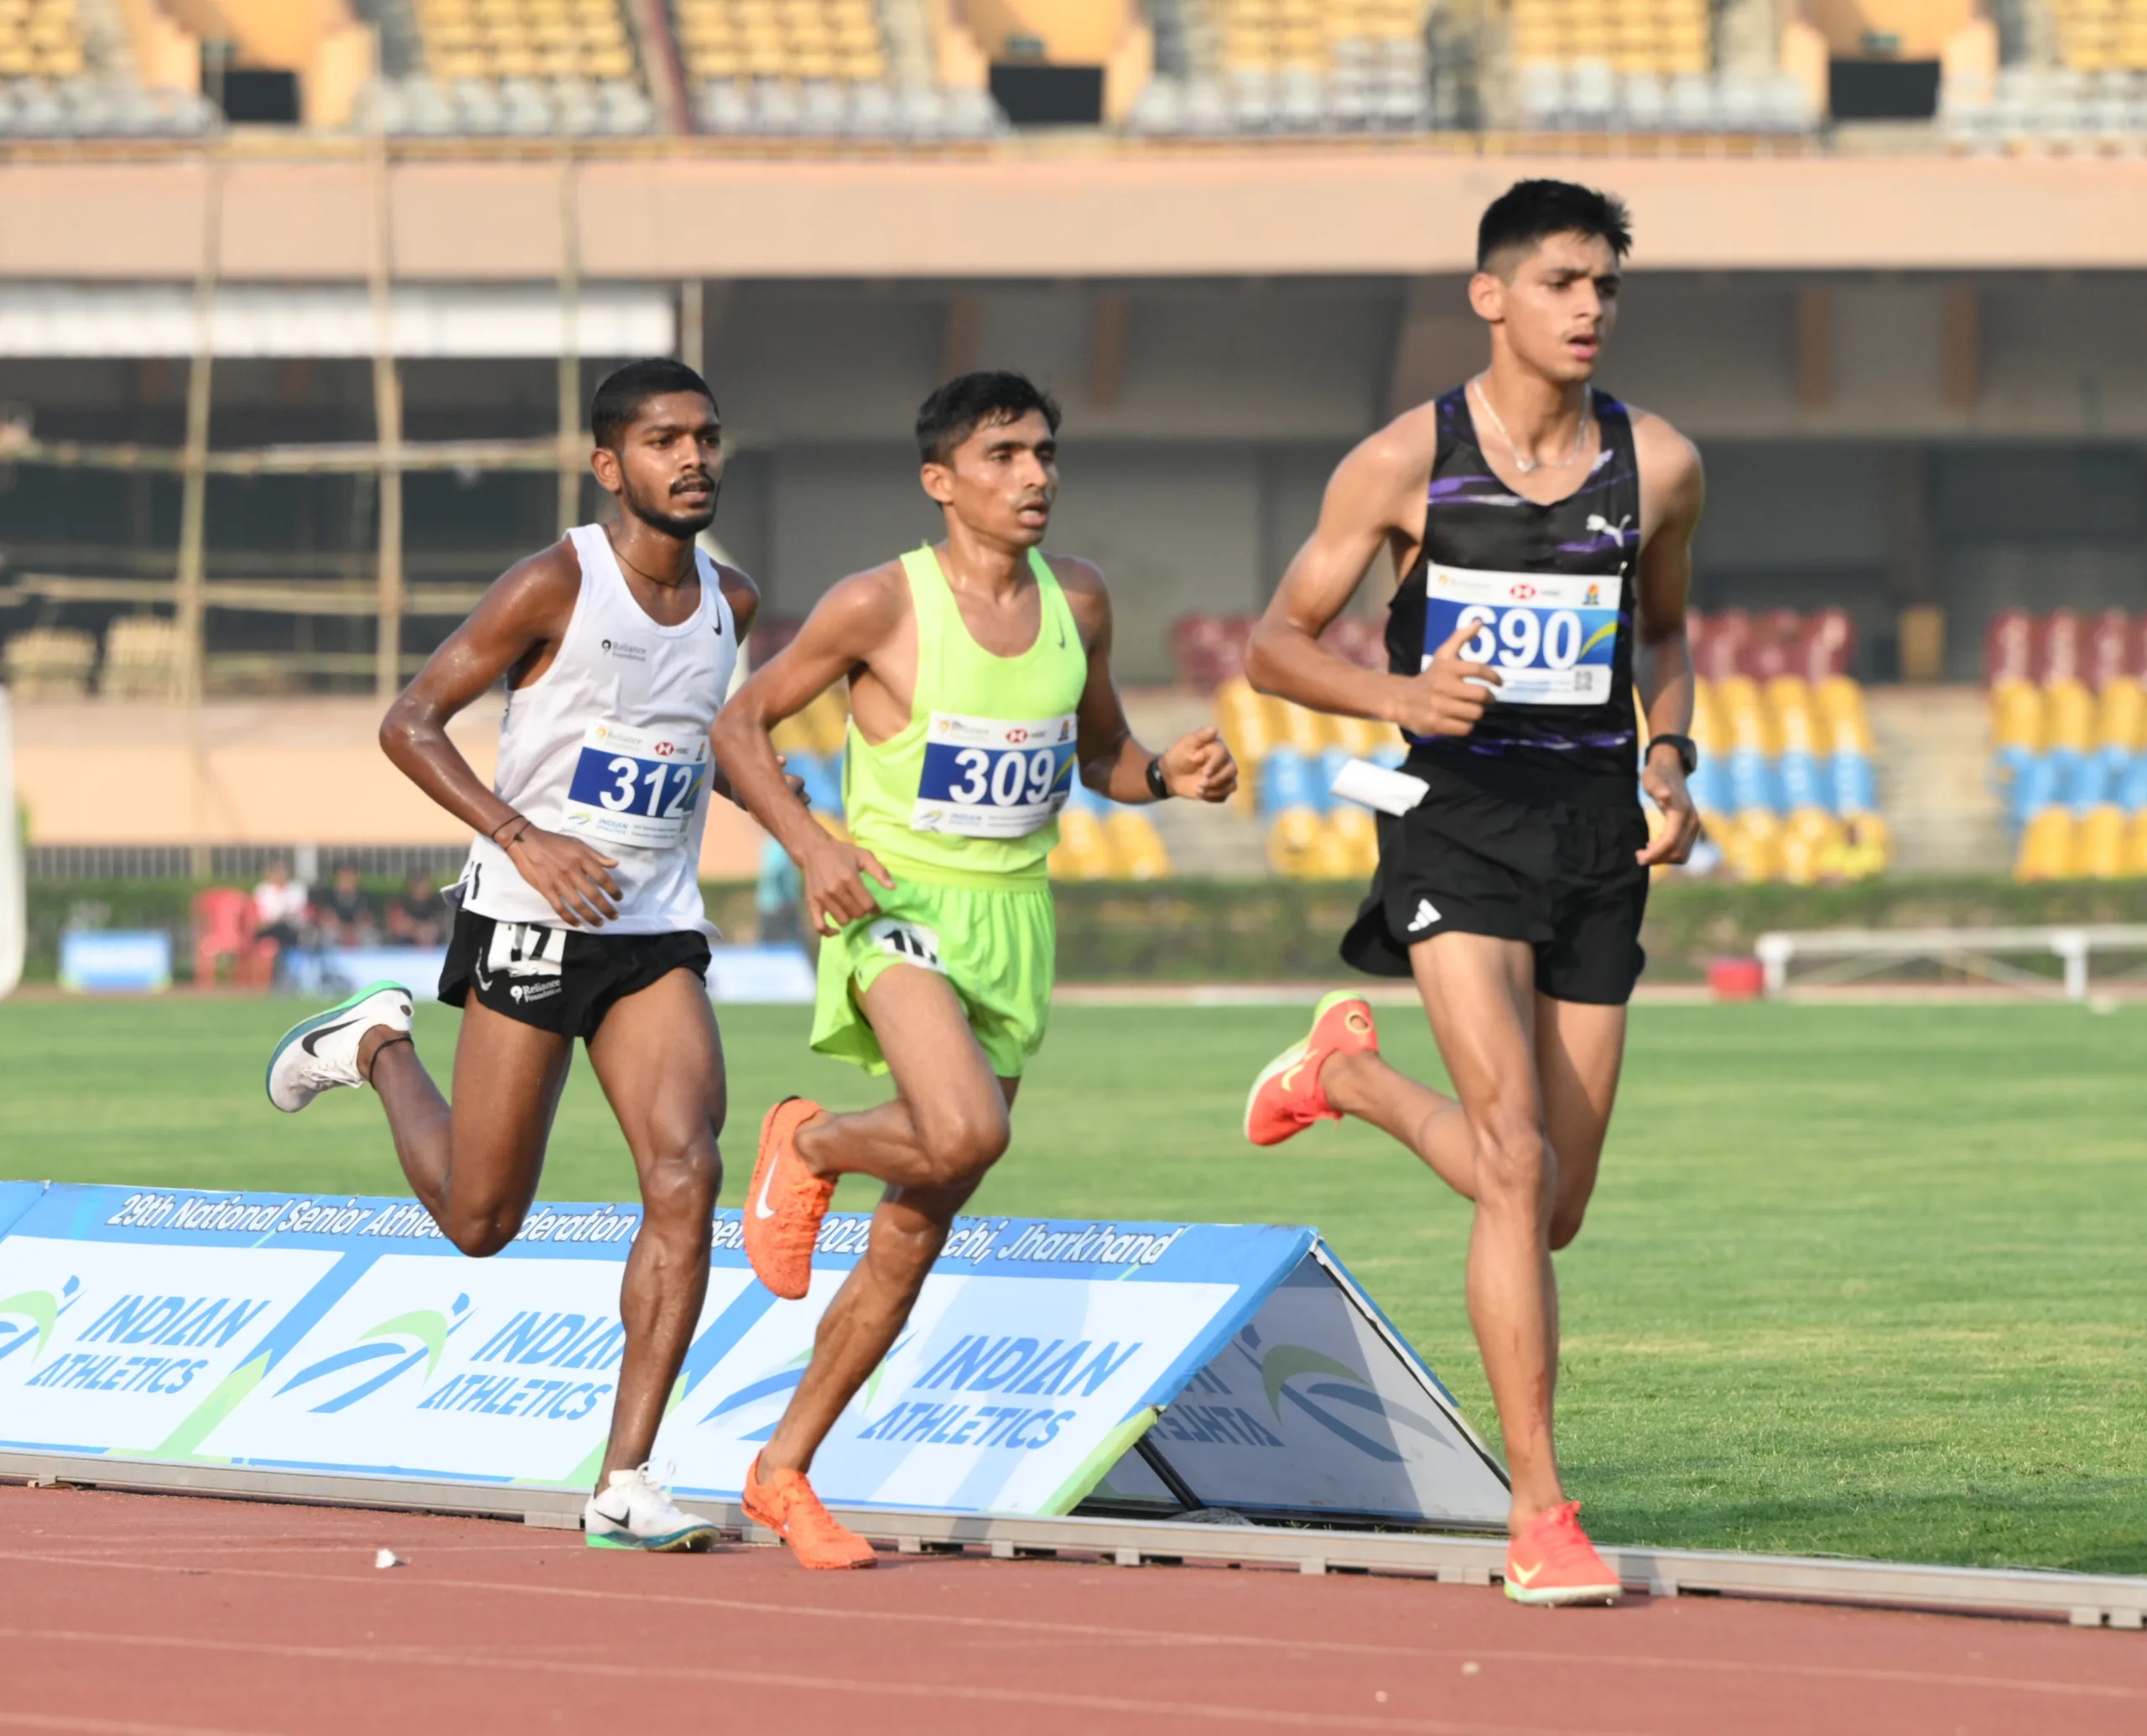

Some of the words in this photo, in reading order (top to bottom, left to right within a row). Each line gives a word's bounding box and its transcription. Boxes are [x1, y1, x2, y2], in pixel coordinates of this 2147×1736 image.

[1456, 605, 1583, 670] 690
[599, 756, 693, 819] 312
[949, 748, 1055, 808] 309
[522, 979, 561, 995] Reliance
[106, 1193, 175, 1229] 29th
[162, 1194, 297, 1233] National
[275, 1194, 376, 1236] Senior
[356, 1202, 444, 1239] Athle
[513, 1203, 638, 1244] deration
[996, 1221, 1188, 1266] Jharkhand
[75, 1294, 272, 1349] INDIAN
[23, 1353, 210, 1395] ATHLETICS
[912, 1334, 1143, 1398] INDIAN
[415, 1373, 614, 1421] ATHLETICS
[855, 1401, 1077, 1450] ATHLETICS
